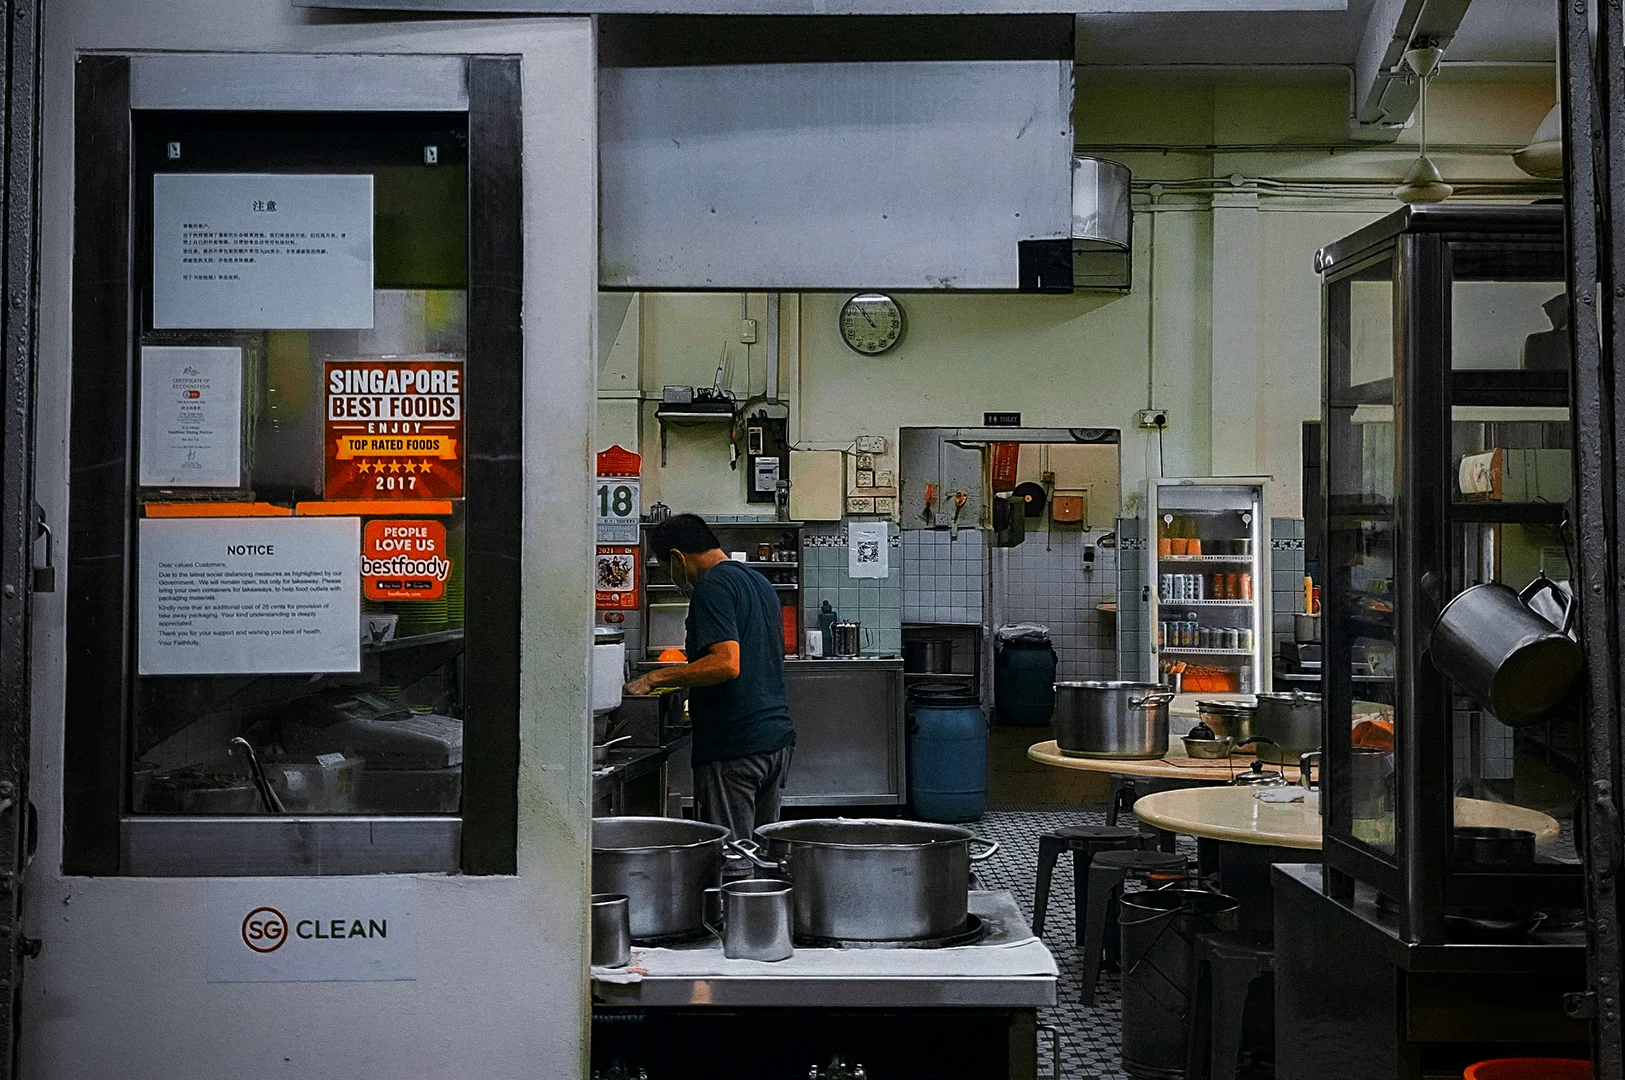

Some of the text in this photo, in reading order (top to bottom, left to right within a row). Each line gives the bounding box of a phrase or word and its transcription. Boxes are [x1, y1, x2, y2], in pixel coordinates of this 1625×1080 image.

[252, 200, 277, 212] 注意
[329, 369, 460, 394] SINGAPORE
[332, 397, 455, 418] BEST FOODS
[368, 422, 421, 434] ENJOY
[348, 439, 440, 450] TOP RATED FOODS
[376, 477, 416, 490] 2017
[597, 485, 633, 517] 18
[384, 527, 428, 538] PEOPLE
[227, 545, 275, 556] NOTICE
[375, 539, 435, 551] LOVE US
[361, 555, 449, 580] bestfoody
[249, 919, 387, 940] SG CLEAN
